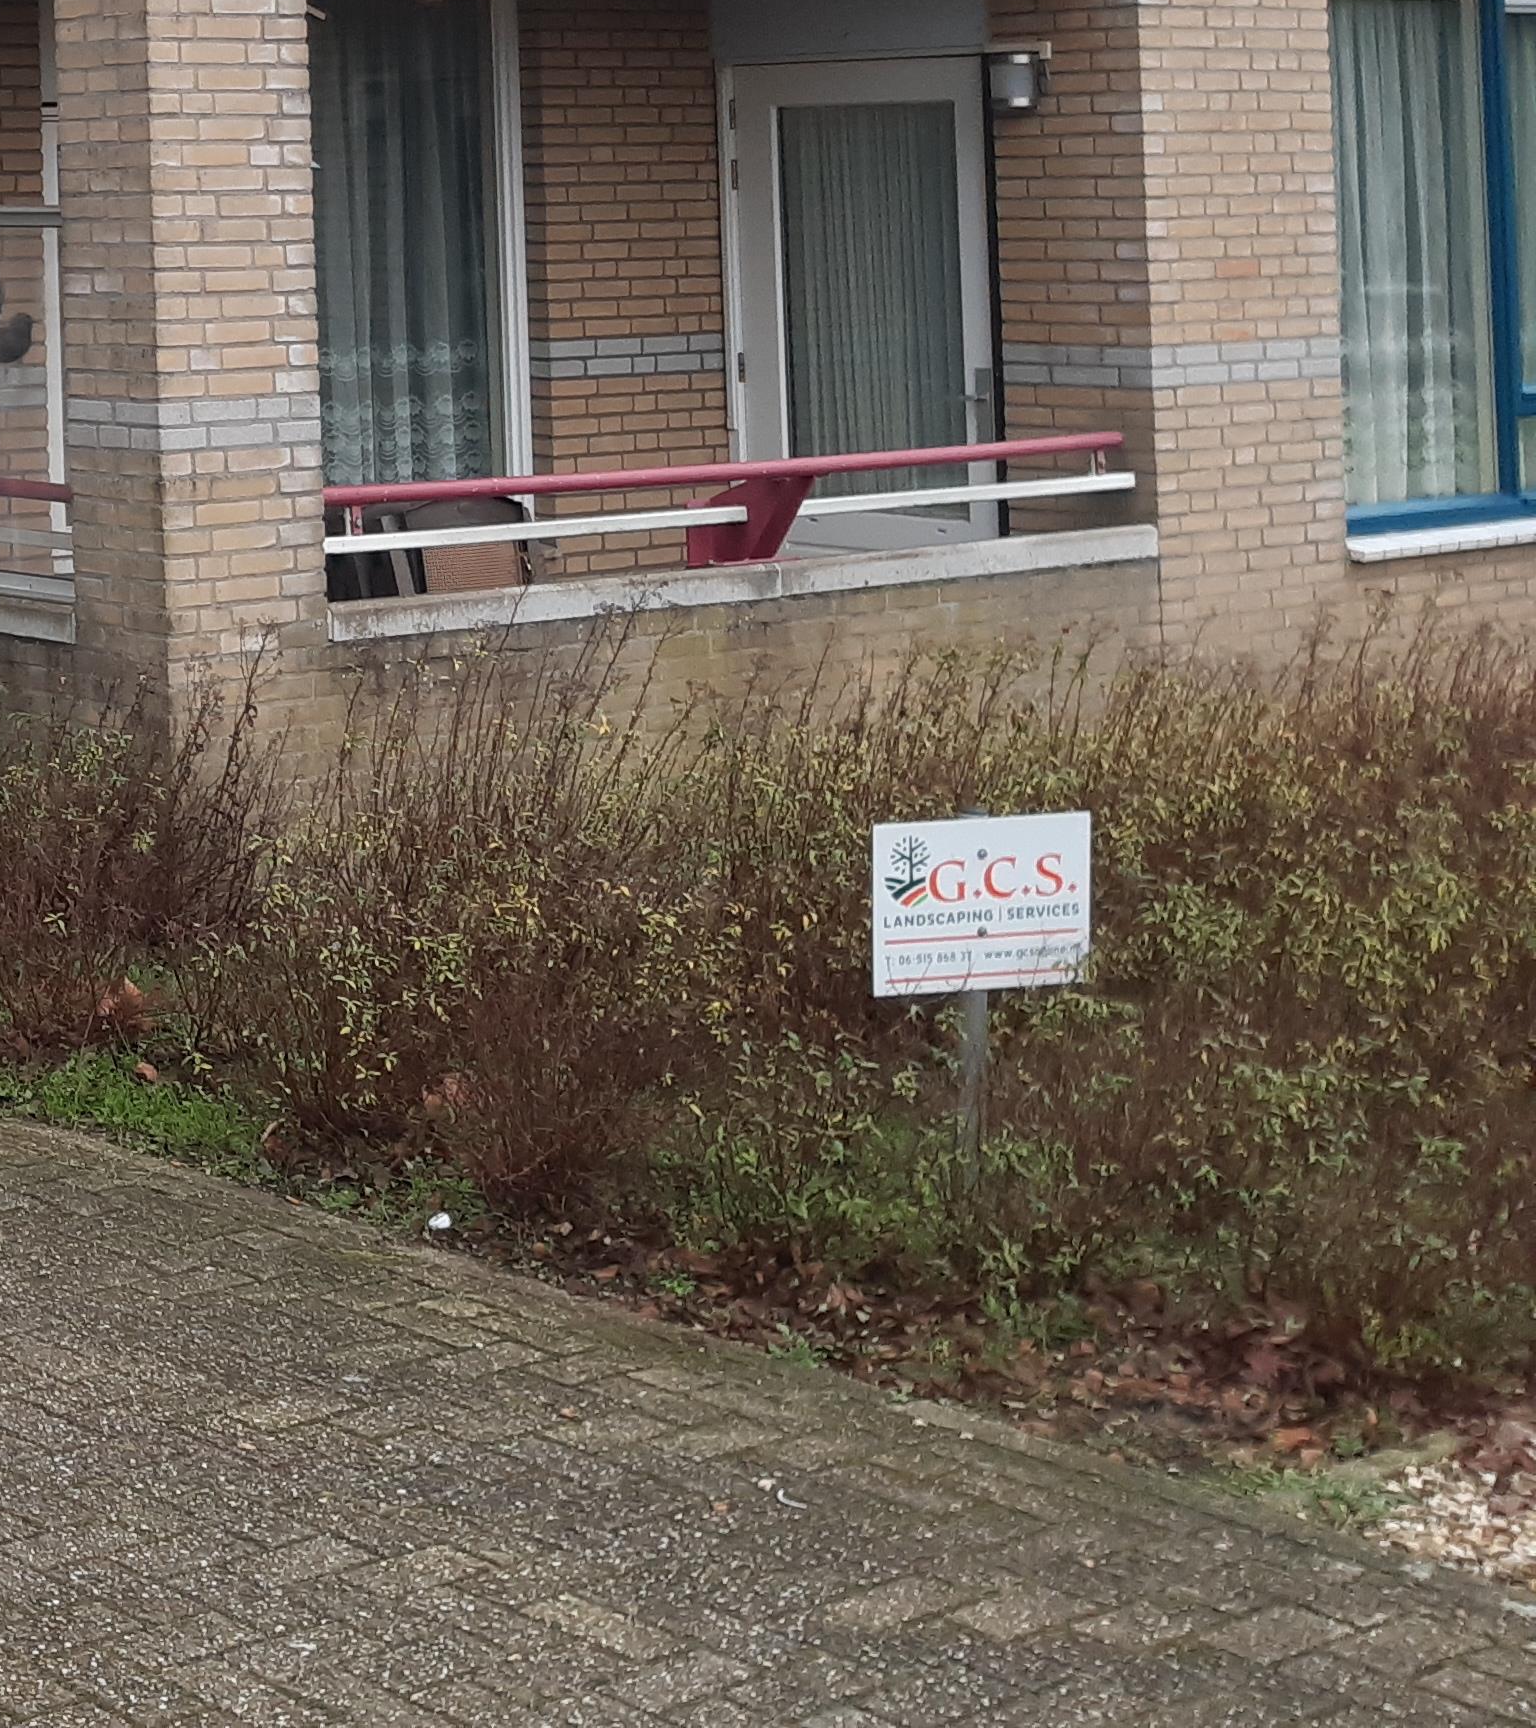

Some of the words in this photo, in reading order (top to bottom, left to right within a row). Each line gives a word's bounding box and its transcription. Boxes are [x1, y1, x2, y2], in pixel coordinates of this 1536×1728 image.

[929, 853, 1077, 903] G.C.S.
[883, 908, 993, 929] LANDSCAPING
[1008, 903, 1079, 920] SERVICES
